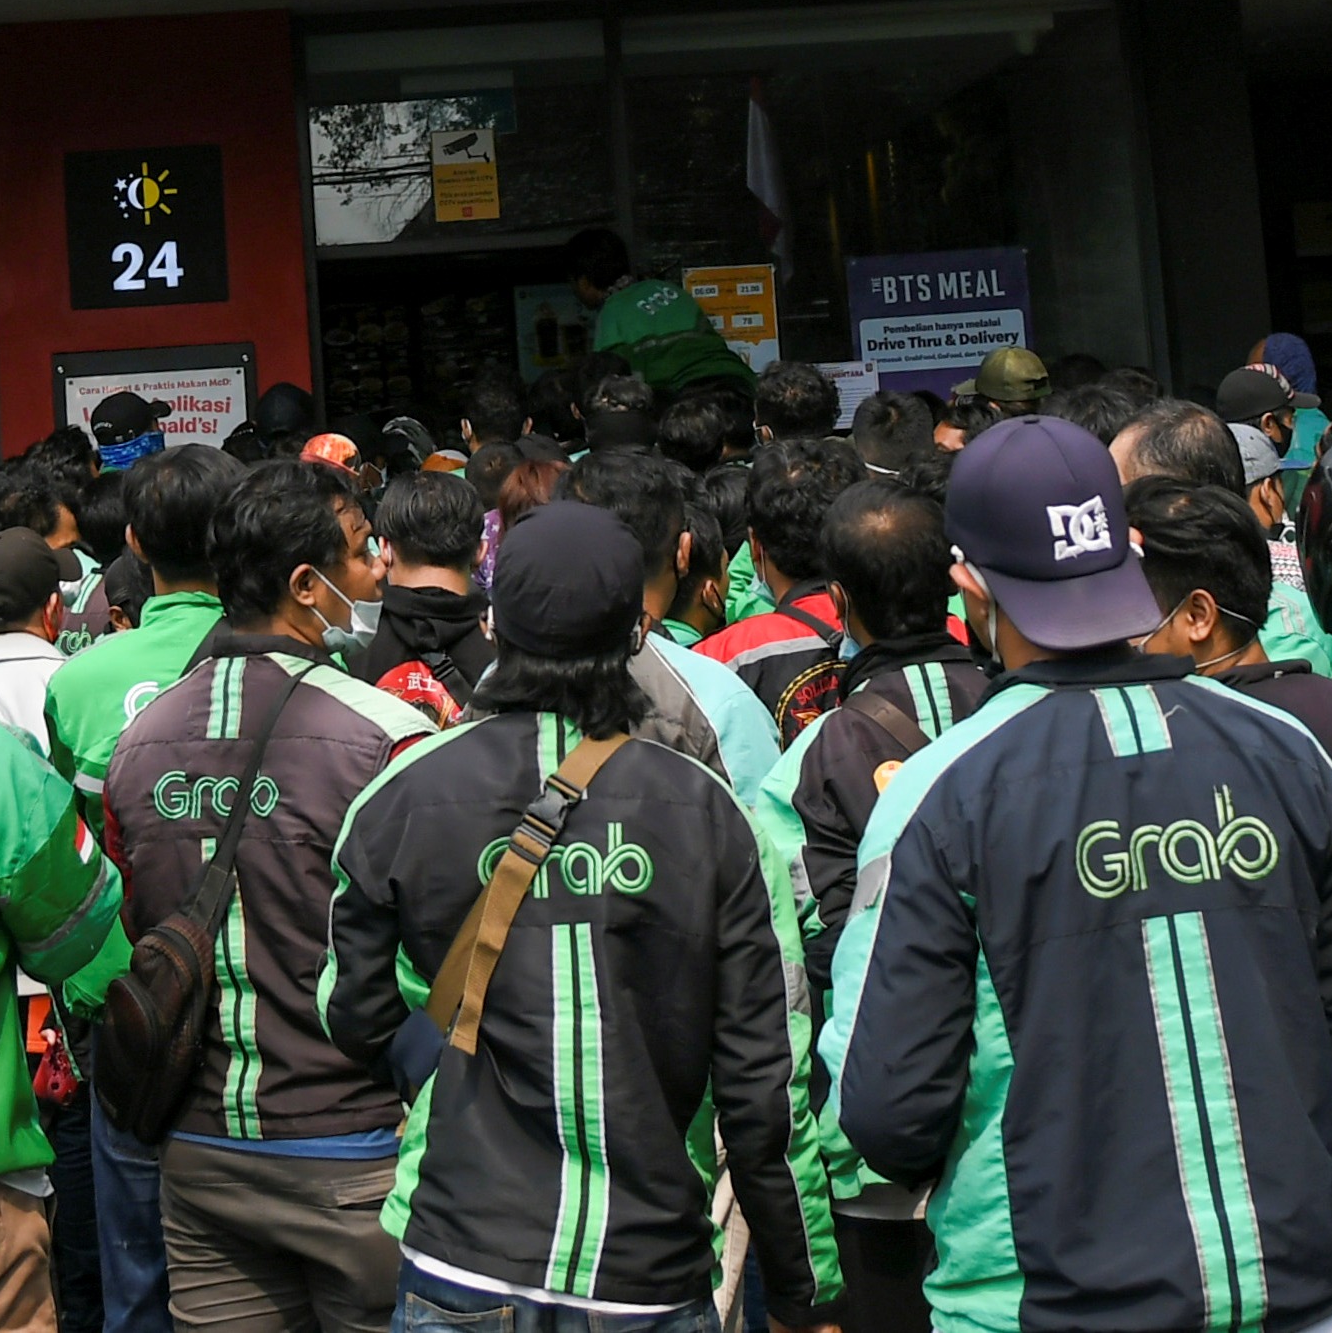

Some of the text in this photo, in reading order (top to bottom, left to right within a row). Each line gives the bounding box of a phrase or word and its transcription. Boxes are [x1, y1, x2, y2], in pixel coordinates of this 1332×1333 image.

[111, 241, 185, 291] 24
[883, 273, 932, 304] BTS
[937, 268, 1006, 300] MEAL
[883, 316, 1001, 335] Pembelian hanya melalui
[867, 329, 1019, 352] Drive Thru & Delivery
[79, 386, 100, 396] Cara
[143, 381, 175, 391] Praktis
[177, 380, 208, 389] Makan
[209, 378, 232, 387] McD:
[152, 394, 232, 414] plikasi
[54, 622, 94, 656] rab
[1075, 783, 1279, 899] Grab
